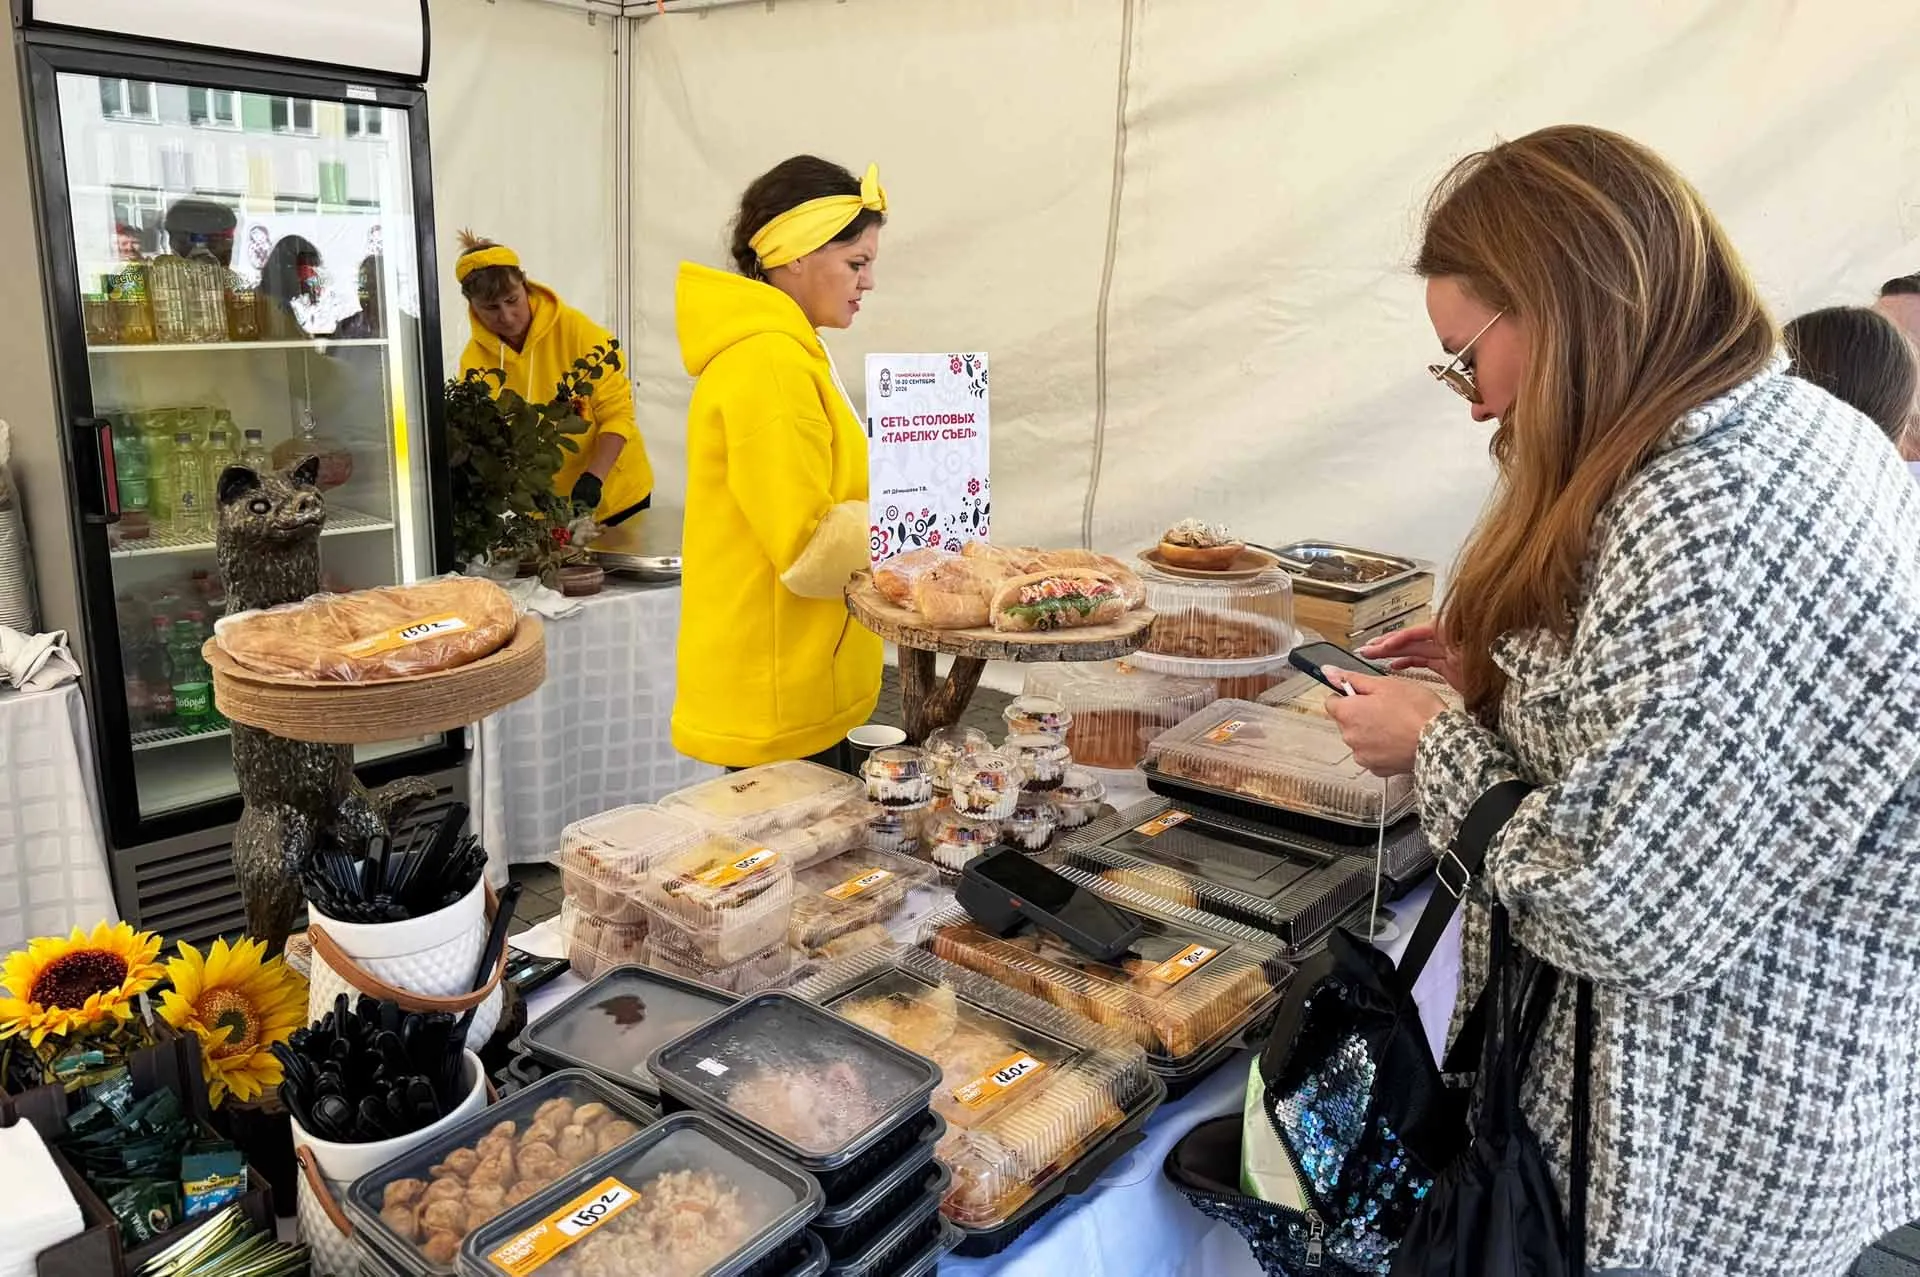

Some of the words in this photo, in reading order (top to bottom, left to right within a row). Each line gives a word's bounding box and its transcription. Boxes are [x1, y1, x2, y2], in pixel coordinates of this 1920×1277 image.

[881, 416, 910, 428] СЕТЬ
[912, 413, 975, 426] СТОЛОВЫХ
[882, 430, 939, 443] «ТАРЕЛКУ
[942, 427, 977, 439] СЪЕЛ»
